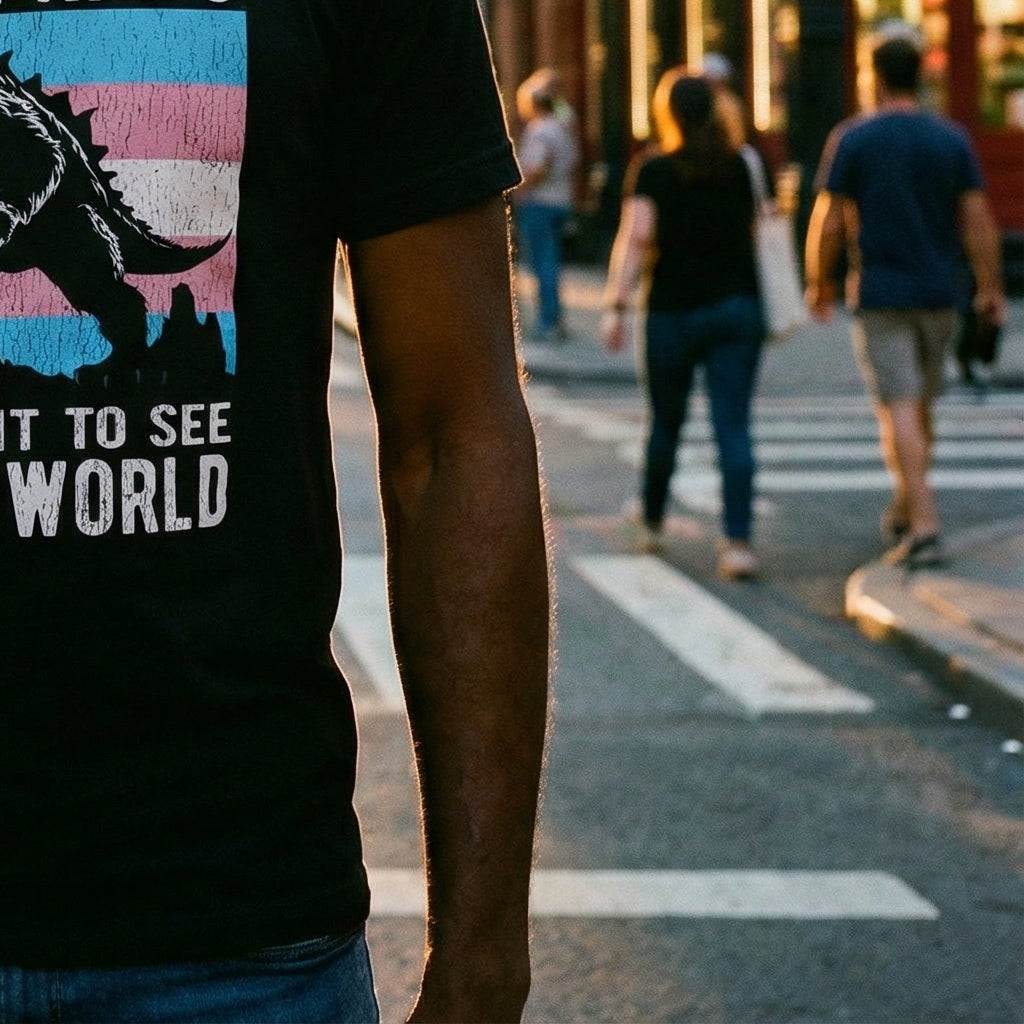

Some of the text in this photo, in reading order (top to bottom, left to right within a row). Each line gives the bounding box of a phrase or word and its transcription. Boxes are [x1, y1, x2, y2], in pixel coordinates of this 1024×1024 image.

[64, 405, 126, 450] TO
[149, 401, 232, 447] SEE
[6, 454, 229, 538] WORLD
